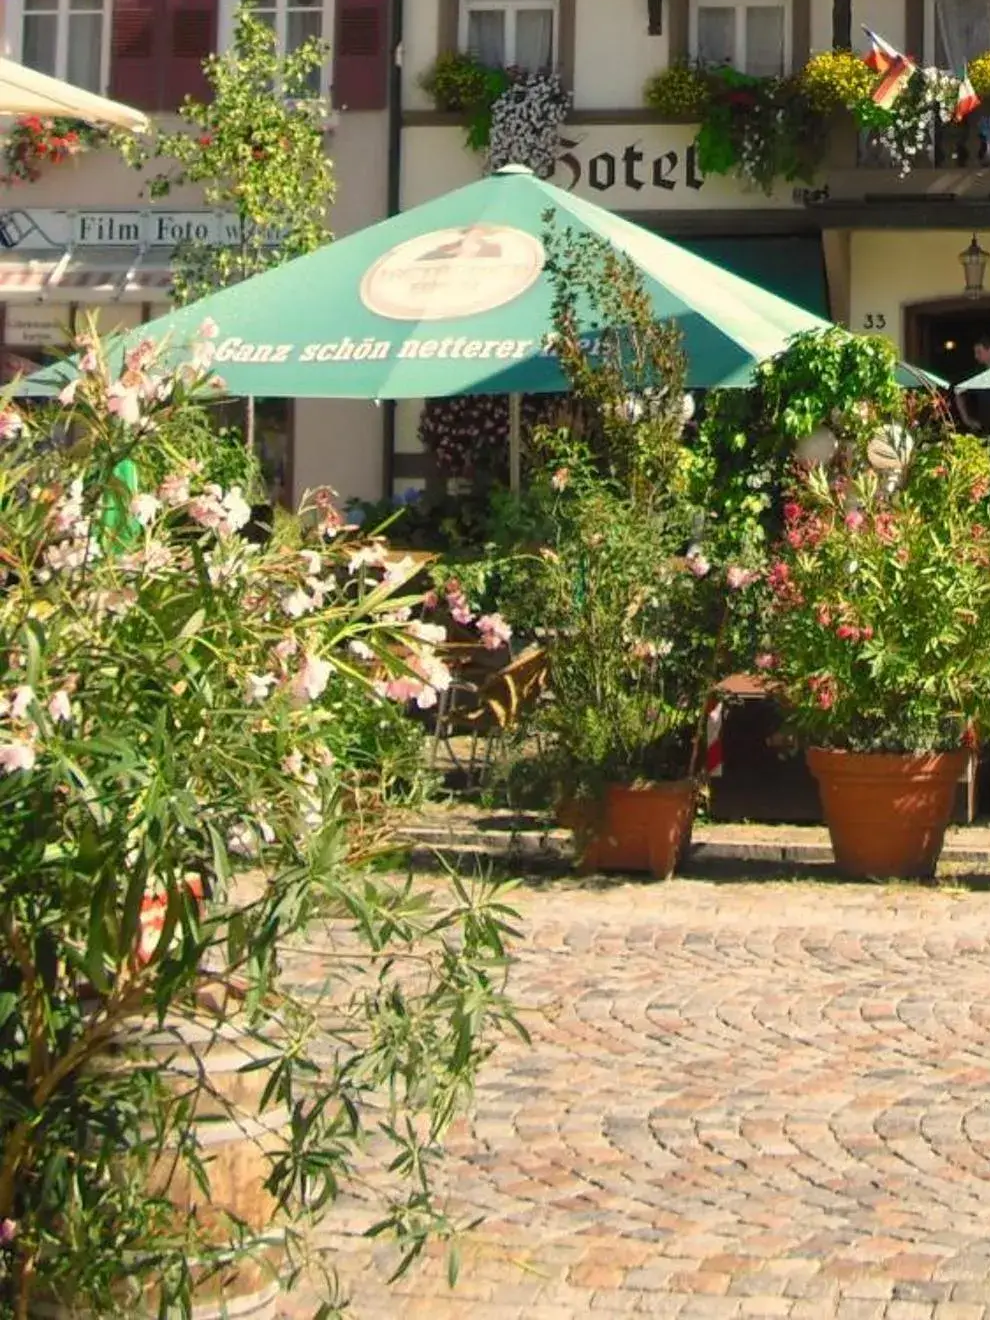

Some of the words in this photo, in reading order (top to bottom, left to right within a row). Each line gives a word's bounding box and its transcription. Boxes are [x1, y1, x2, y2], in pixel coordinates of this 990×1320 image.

[548, 133, 705, 191] Hotel
[79, 218, 139, 240] Film
[157, 217, 209, 240] Foto
[863, 313, 887, 329] 33
[214, 337, 294, 363] Ganz
[298, 337, 392, 361] schön
[396, 336, 533, 359] netterer
